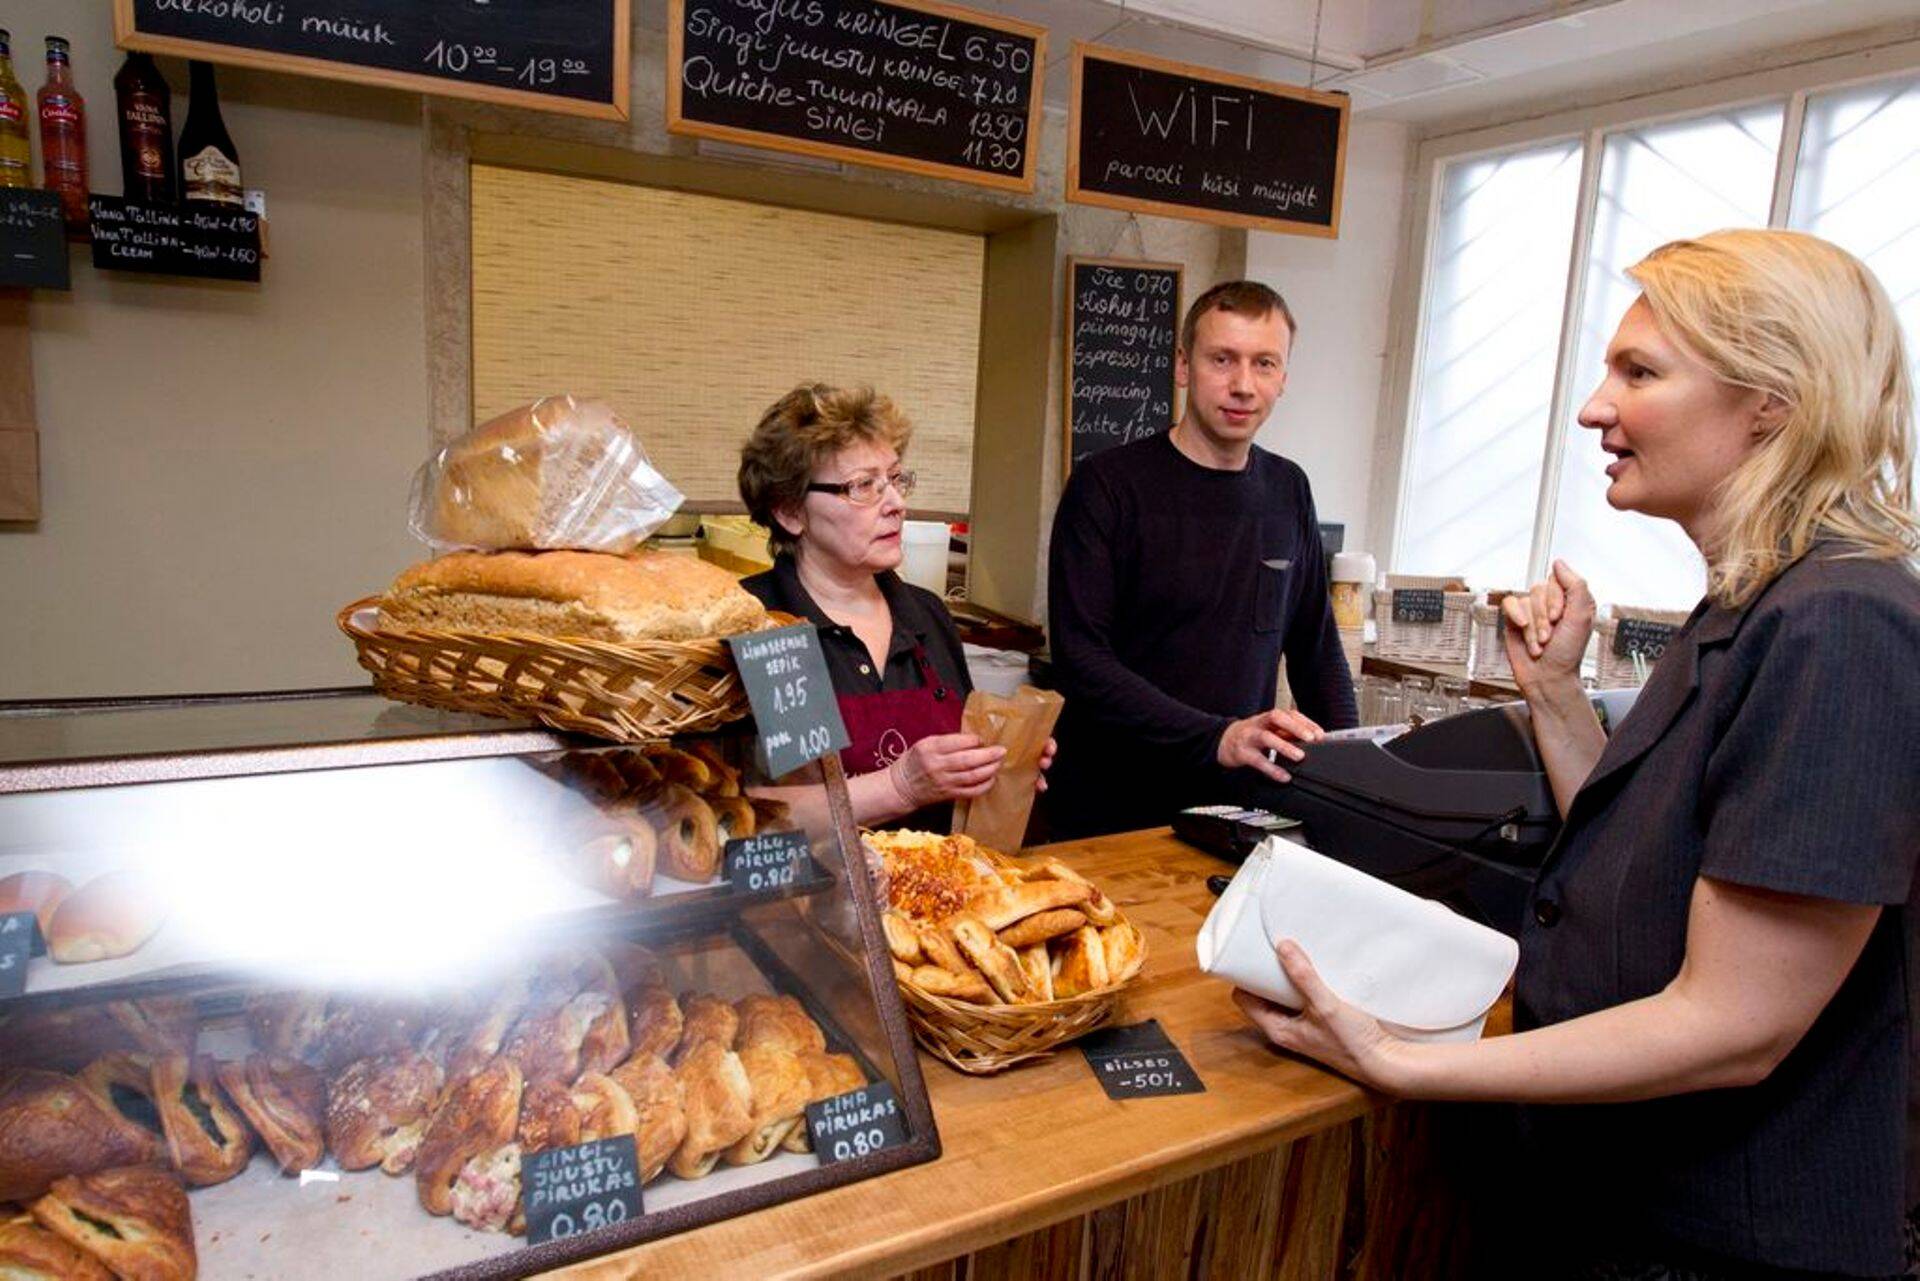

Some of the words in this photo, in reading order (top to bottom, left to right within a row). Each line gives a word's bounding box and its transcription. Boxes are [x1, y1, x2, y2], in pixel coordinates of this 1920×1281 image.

[301, 15, 395, 46] müük
[835, 8, 956, 61] KRINGEL
[964, 35, 1031, 74] 6.50
[805, 106, 885, 142] SINGI
[1202, 172, 1240, 197] küsi
[1252, 180, 1319, 211] müüjalt
[1091, 267, 1127, 290] Tee
[1073, 343, 1141, 370] Espresso
[1072, 410, 1121, 440] Latte
[773, 675, 808, 714] 1.95
[814, 1098, 897, 1138] PIRUKAS
[834, 1128, 885, 1161] 0.80
[531, 1170, 636, 1207] PIRUKAS
[534, 1157, 624, 1188] JUUSTU
